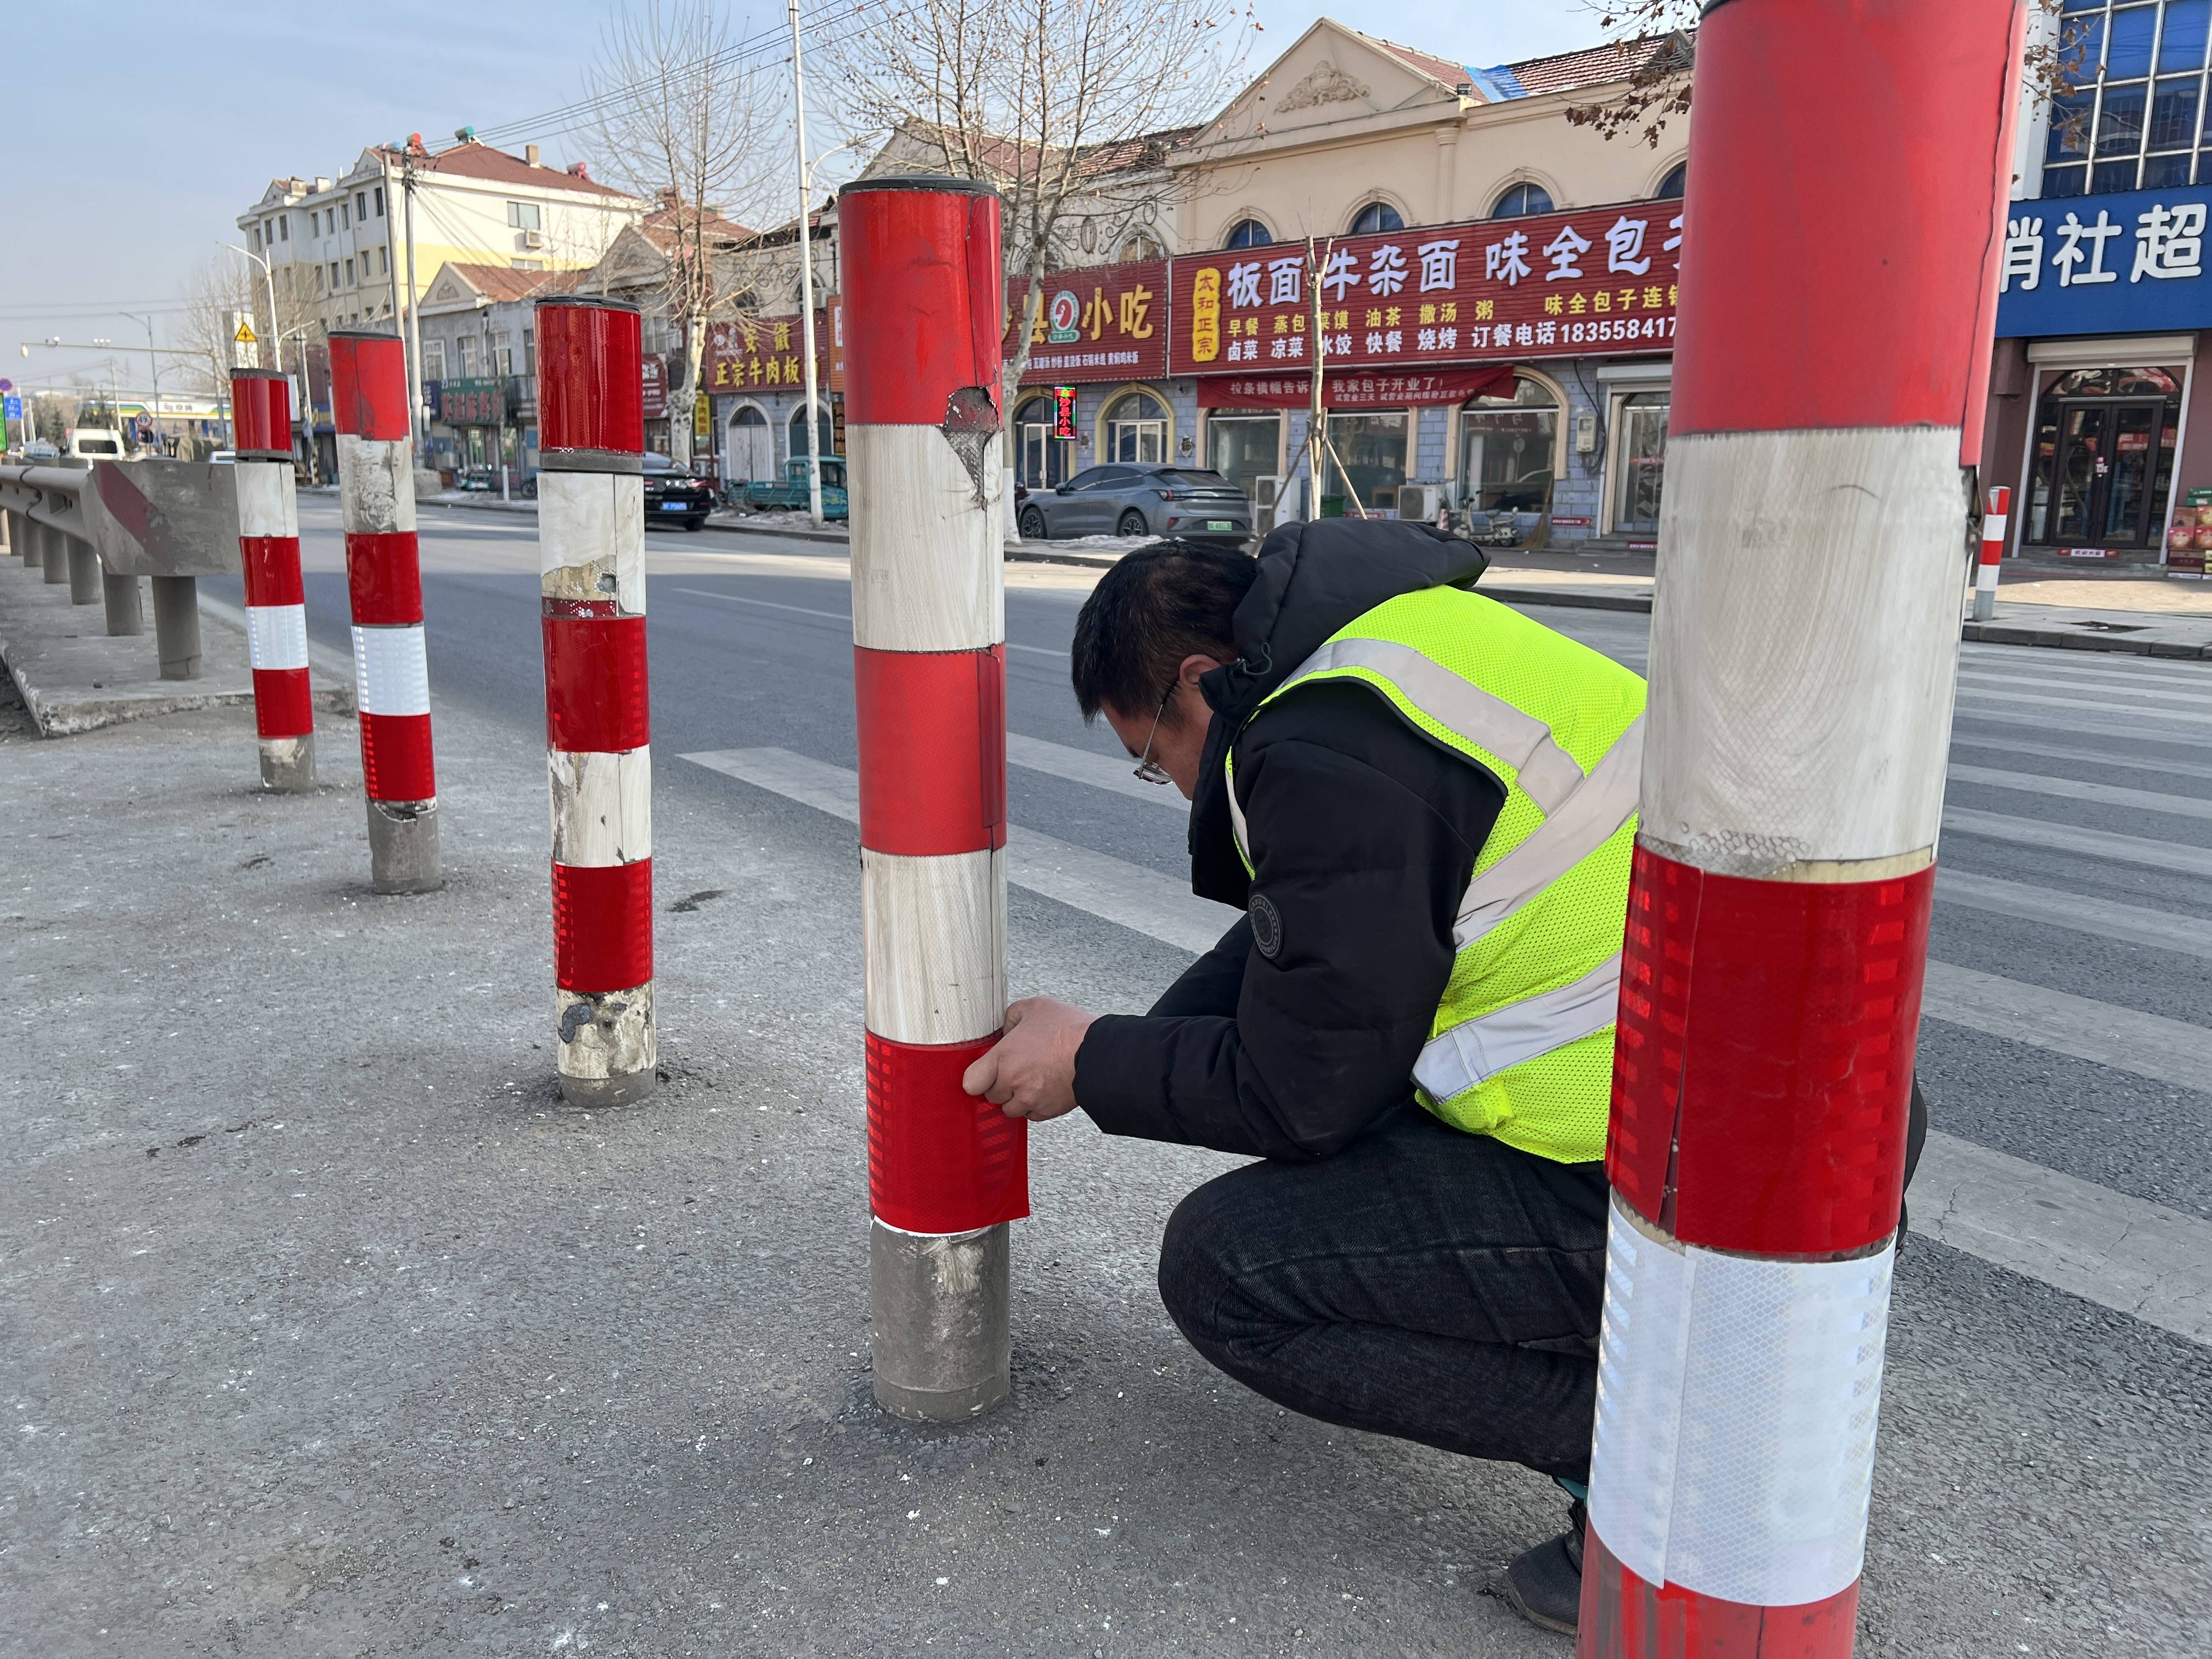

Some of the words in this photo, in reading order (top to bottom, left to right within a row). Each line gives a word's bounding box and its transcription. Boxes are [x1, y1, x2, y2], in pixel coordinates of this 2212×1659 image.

[1227, 257, 1305, 309] 板面
[1323, 240, 1460, 301] 牛杂面
[1002, 292, 1048, 344] 县
[1081, 284, 1153, 341] 小吃
[1198, 274, 1215, 355] 太和正宗
[1229, 318, 1259, 337] 早餐
[1274, 314, 1305, 334] 蒸包
[1366, 307, 1402, 328] 油茶
[1475, 300, 1494, 320] 粥
[1228, 340, 1258, 361] 卤菜
[1271, 336, 1304, 358] 凉菜
[1322, 334, 1352, 356] 水饺
[1366, 331, 1402, 354] 快餐
[1417, 328, 1457, 351] 烧烤
[715, 356, 819, 387] 正宗牛肉板
[1059, 397, 1071, 436] 沙县小吃
